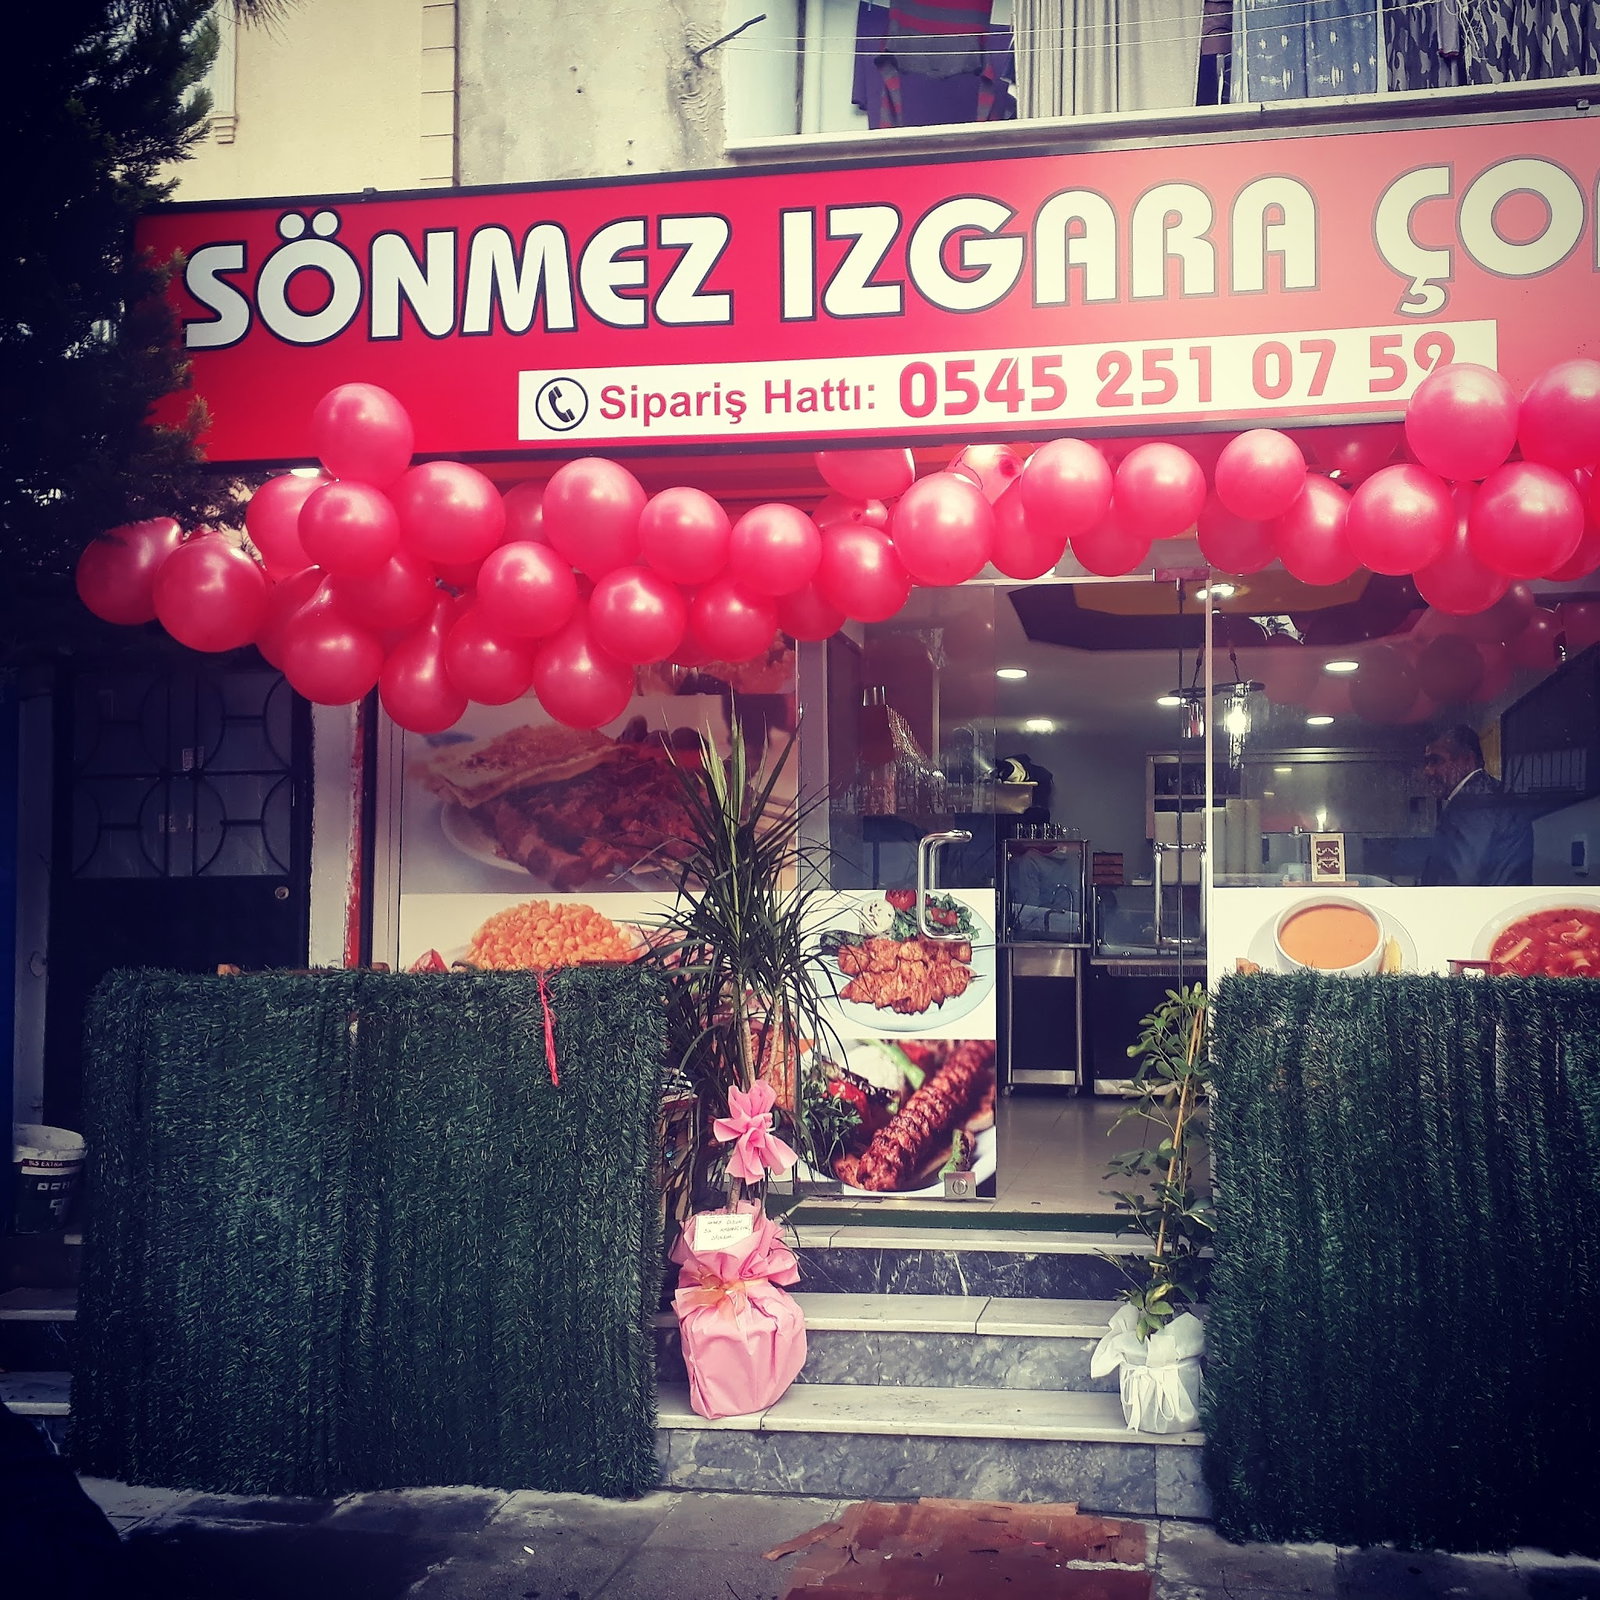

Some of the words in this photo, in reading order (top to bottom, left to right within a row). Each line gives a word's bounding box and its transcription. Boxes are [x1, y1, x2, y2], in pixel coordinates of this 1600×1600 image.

[185, 209, 733, 349] SÖNMEZ
[779, 174, 1321, 321] IZGARA
[1371, 154, 1600, 316] ÇO
[599, 382, 747, 427] Sipariş
[764, 377, 876, 416] Hattı:
[899, 354, 1068, 418] 0545
[1096, 345, 1212, 408] 251
[1252, 338, 1337, 400] 07
